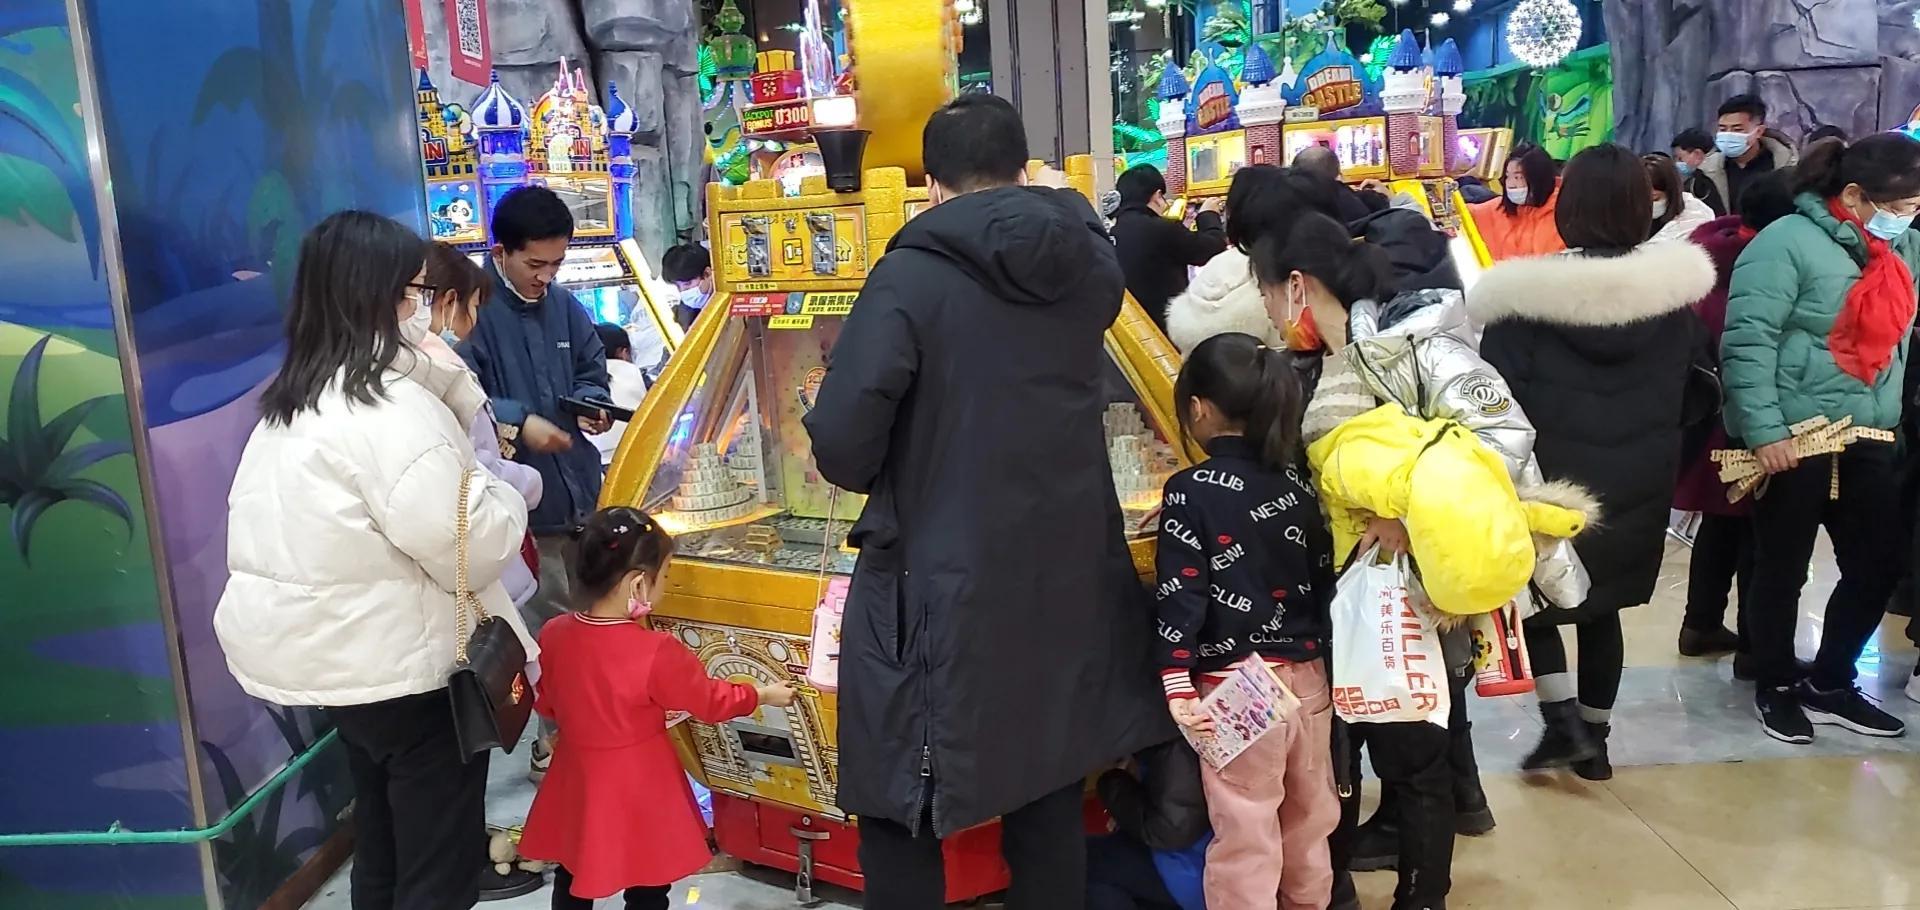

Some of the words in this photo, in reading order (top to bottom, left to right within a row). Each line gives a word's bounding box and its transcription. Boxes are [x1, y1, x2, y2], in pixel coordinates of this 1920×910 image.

[1309, 66, 1352, 90] DREAM
[1304, 83, 1362, 109] CASTLE
[743, 109, 773, 121] JACKPOT
[747, 119, 773, 130] BONUS
[1192, 469, 1245, 492] CLUB
[1285, 469, 1316, 498] CLUB
[1249, 491, 1299, 523] NEW!
[1164, 518, 1203, 551] CLUB
[1209, 583, 1253, 613] CLUB
[1261, 602, 1287, 634] NEW!
